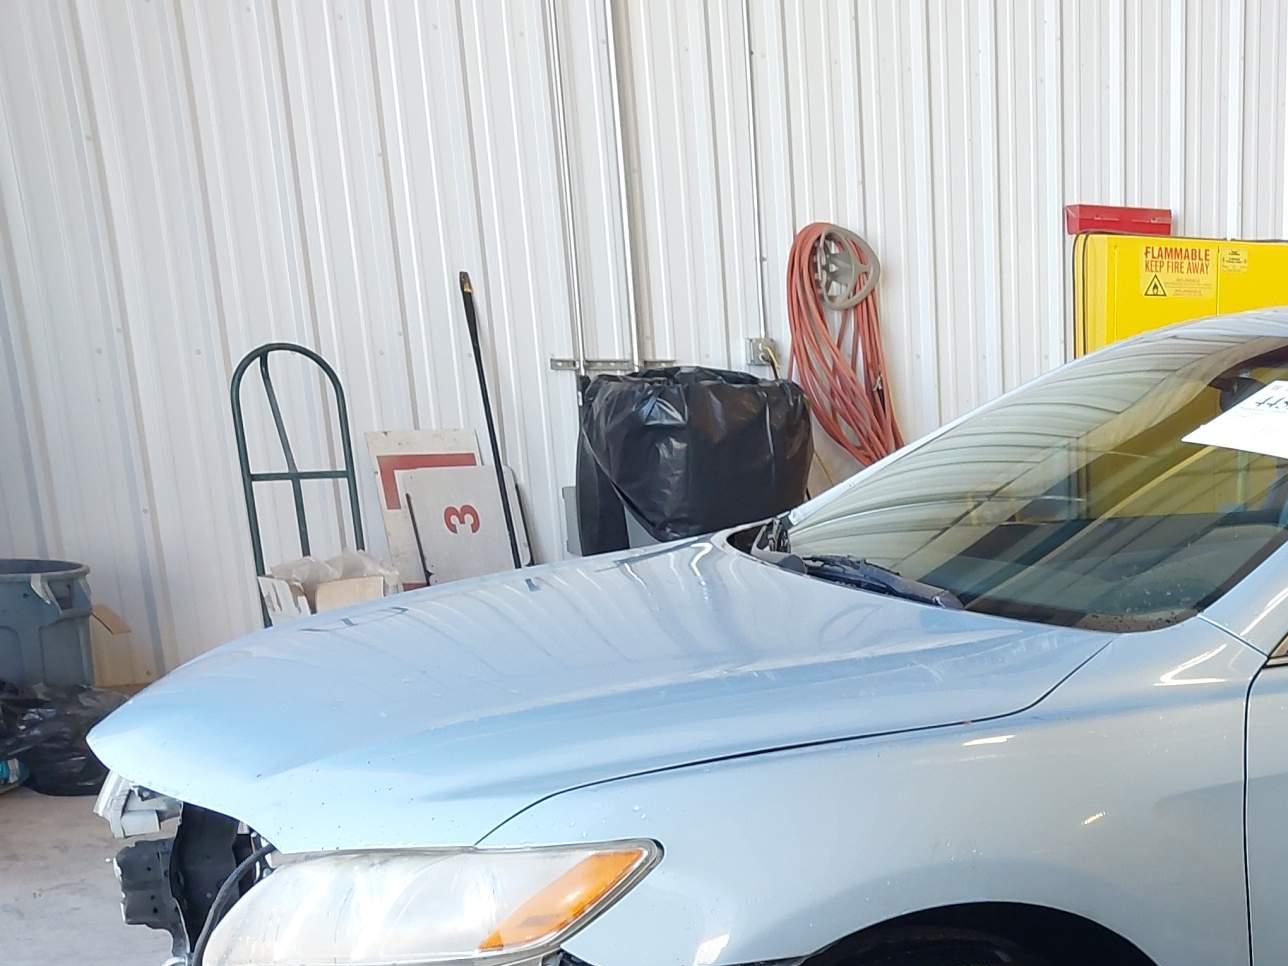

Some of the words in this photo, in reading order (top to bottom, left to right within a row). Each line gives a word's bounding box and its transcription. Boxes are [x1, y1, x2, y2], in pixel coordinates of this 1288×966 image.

[1144, 246, 1210, 261] FLAMMABLE
[1144, 260, 1164, 273] KEEP
[1167, 261, 1184, 274] FIRE
[1186, 262, 1210, 275] AWAY
